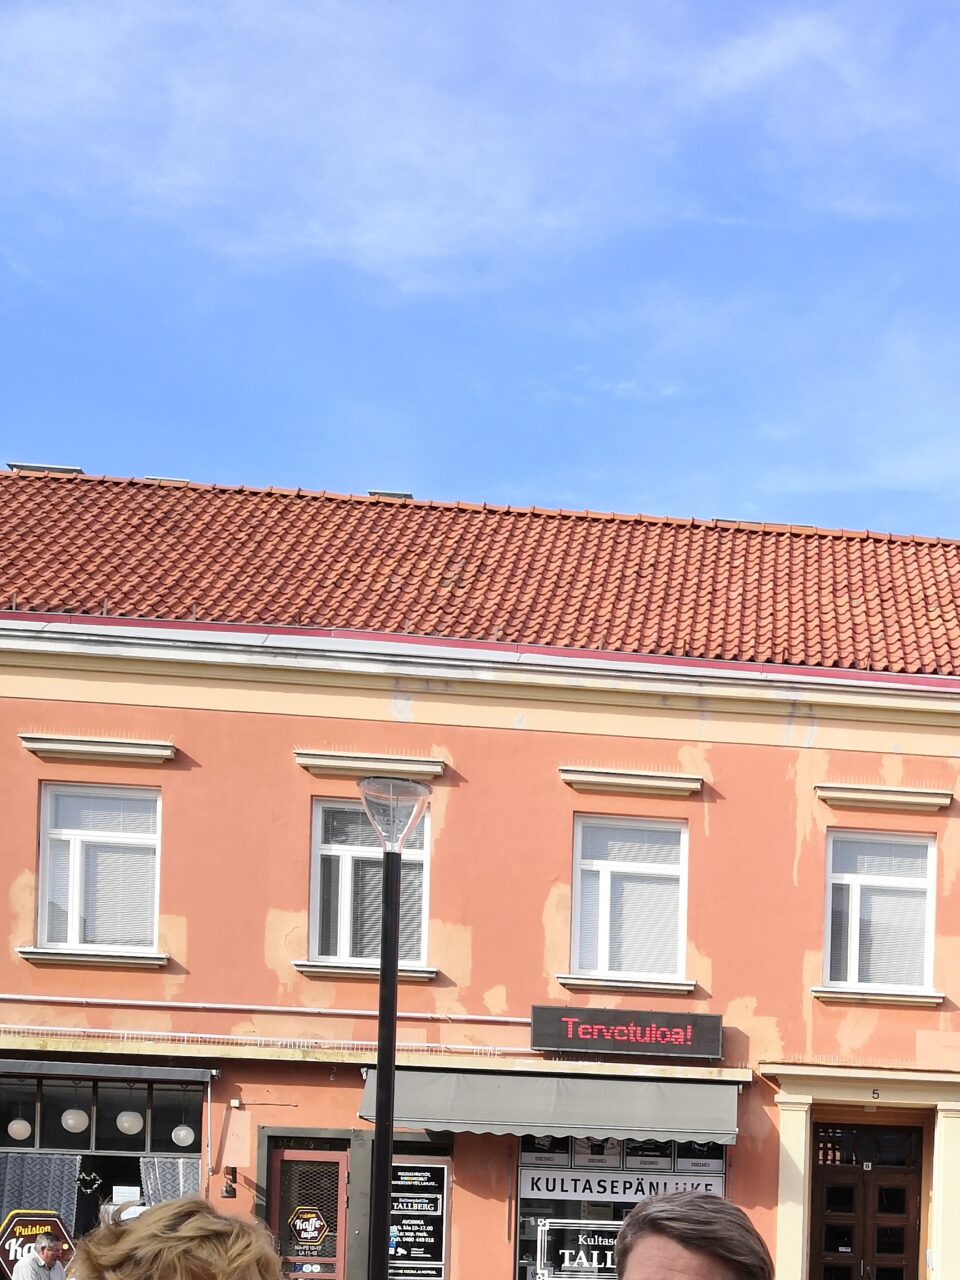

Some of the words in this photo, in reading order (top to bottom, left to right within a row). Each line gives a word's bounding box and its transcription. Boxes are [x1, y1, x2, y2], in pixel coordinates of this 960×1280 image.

[560, 1016, 692, 1045] Tervetuloa!
[872, 1089, 880, 1100] 5
[392, 1202, 435, 1211] TALLBERG
[14, 1224, 52, 1237] Puiston
[559, 1249, 617, 1269] TALL
